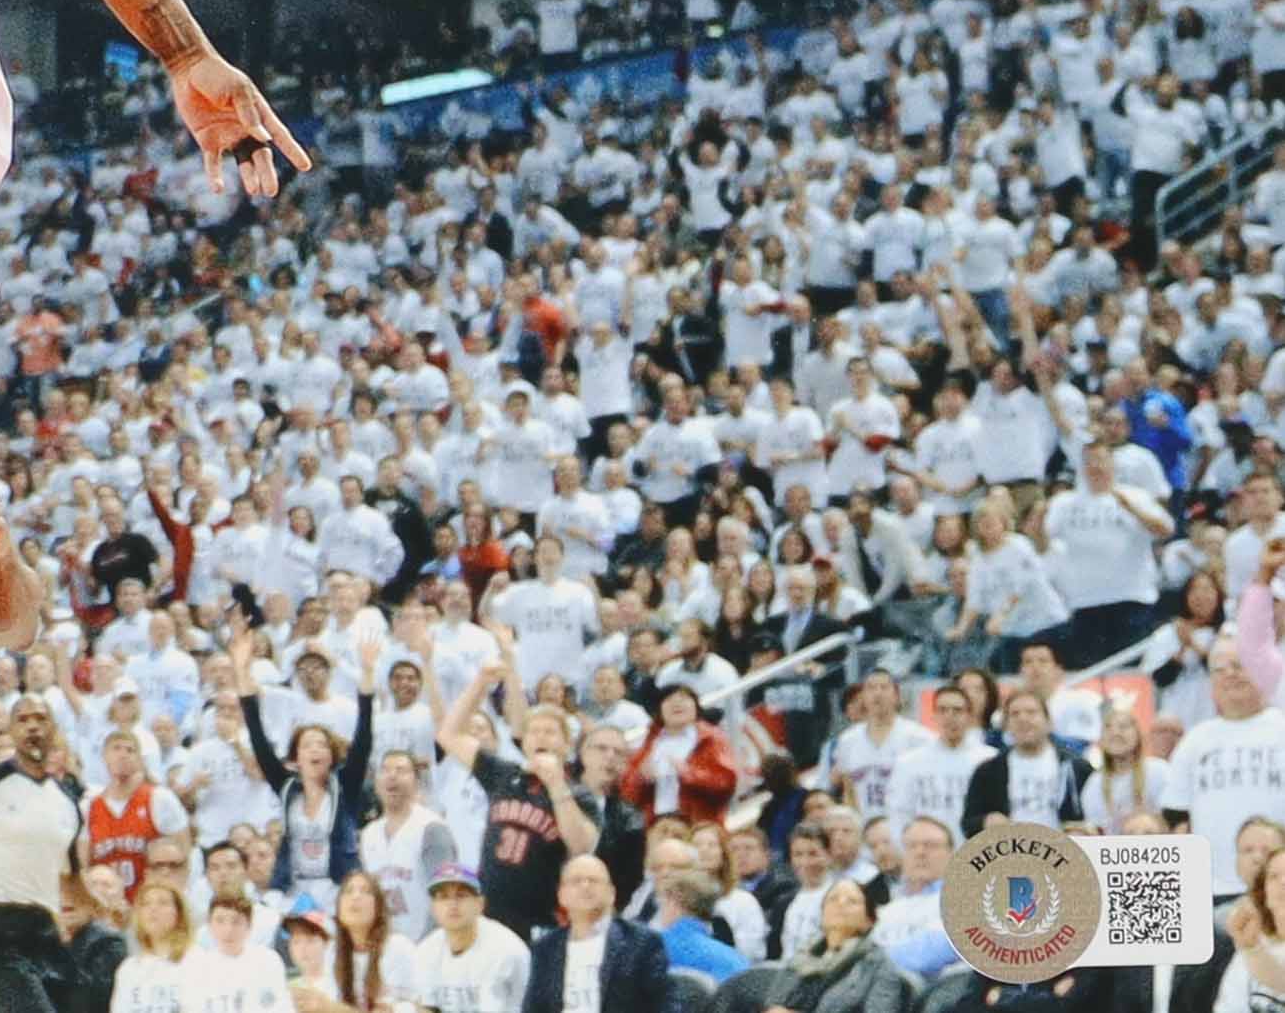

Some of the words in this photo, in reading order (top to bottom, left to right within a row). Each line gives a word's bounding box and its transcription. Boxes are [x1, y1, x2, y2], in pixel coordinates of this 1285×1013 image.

[970, 838, 1068, 873] BECKETT
[1100, 847, 1180, 865] BJ084205
[964, 924, 1076, 965] AUTHENTICATED
